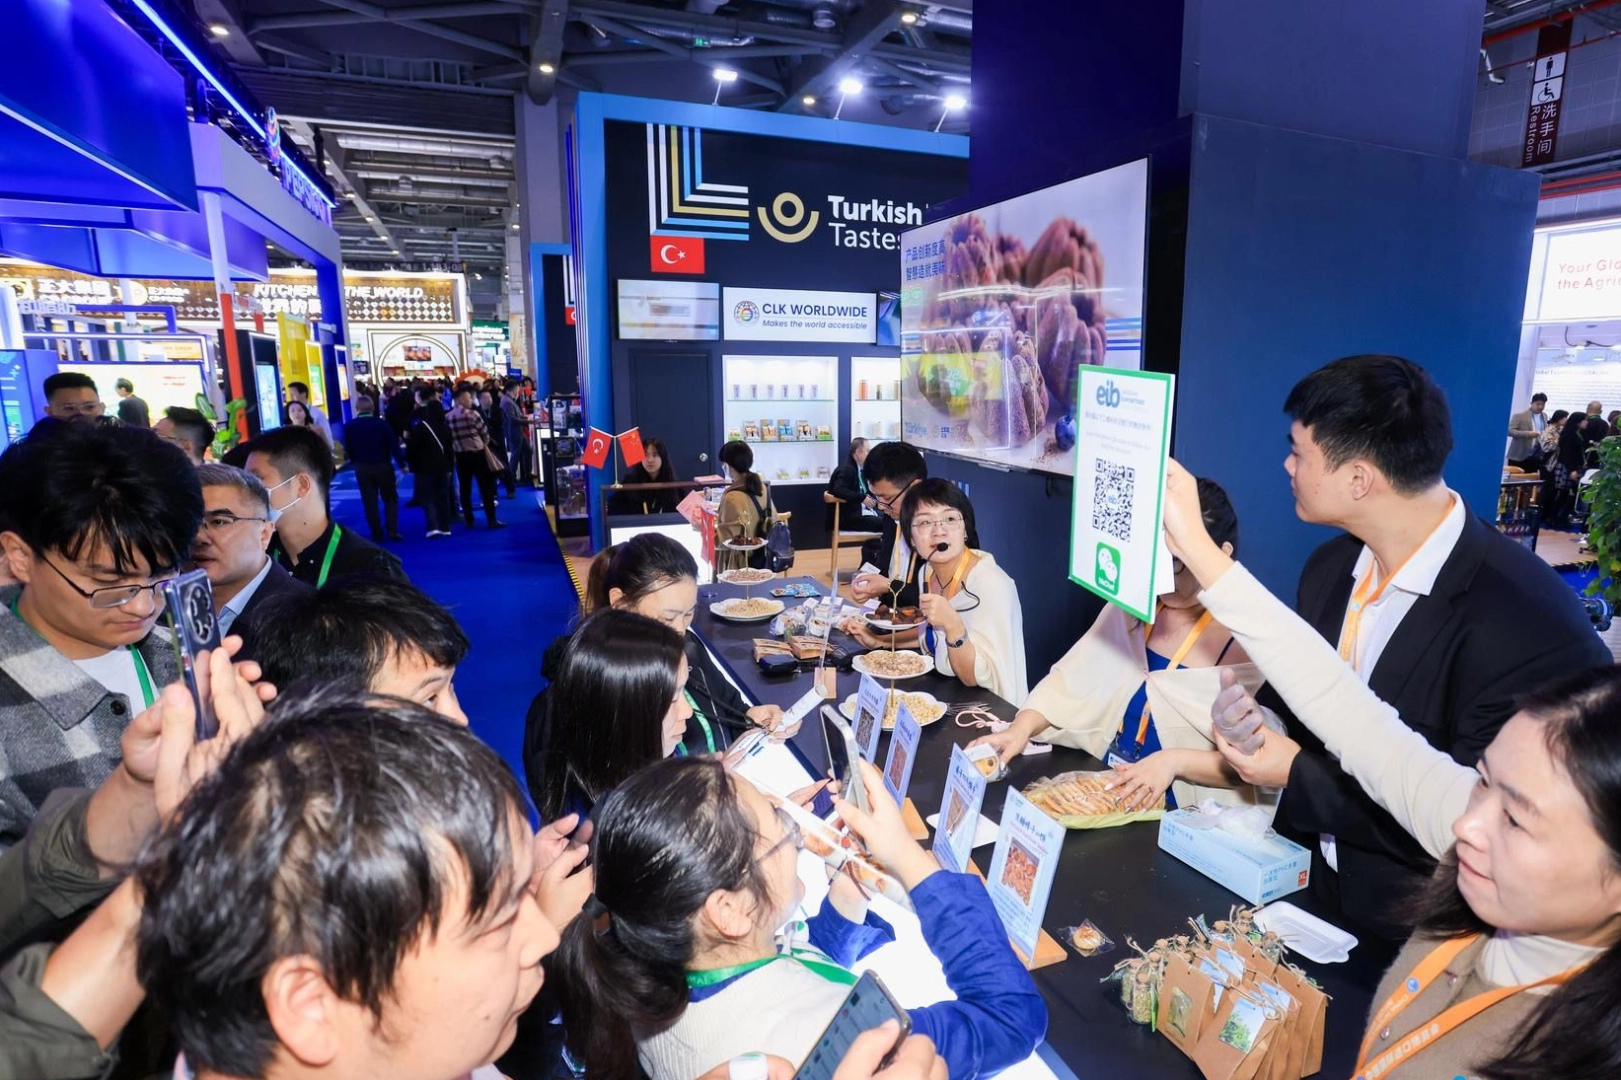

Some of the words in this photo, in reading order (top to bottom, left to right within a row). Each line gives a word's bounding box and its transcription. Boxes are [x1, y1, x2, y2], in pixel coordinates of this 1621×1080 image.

[1525, 106, 1541, 162] Restroom
[1537, 103, 1557, 155] 洗手间
[828, 195, 923, 226] Turkish
[1558, 263, 1592, 274] Your
[253, 284, 317, 298] KITCHEN
[344, 286, 370, 297] THE
[371, 287, 423, 298] WORLD
[1558, 279, 1580, 289] the
[762, 303, 787, 315] CLK
[790, 304, 868, 318] WORLDWIDE
[762, 320, 788, 328] Makes
[790, 320, 803, 328] the
[805, 321, 826, 329] world
[827, 321, 868, 330] accessible
[1096, 380, 1120, 409] eib
